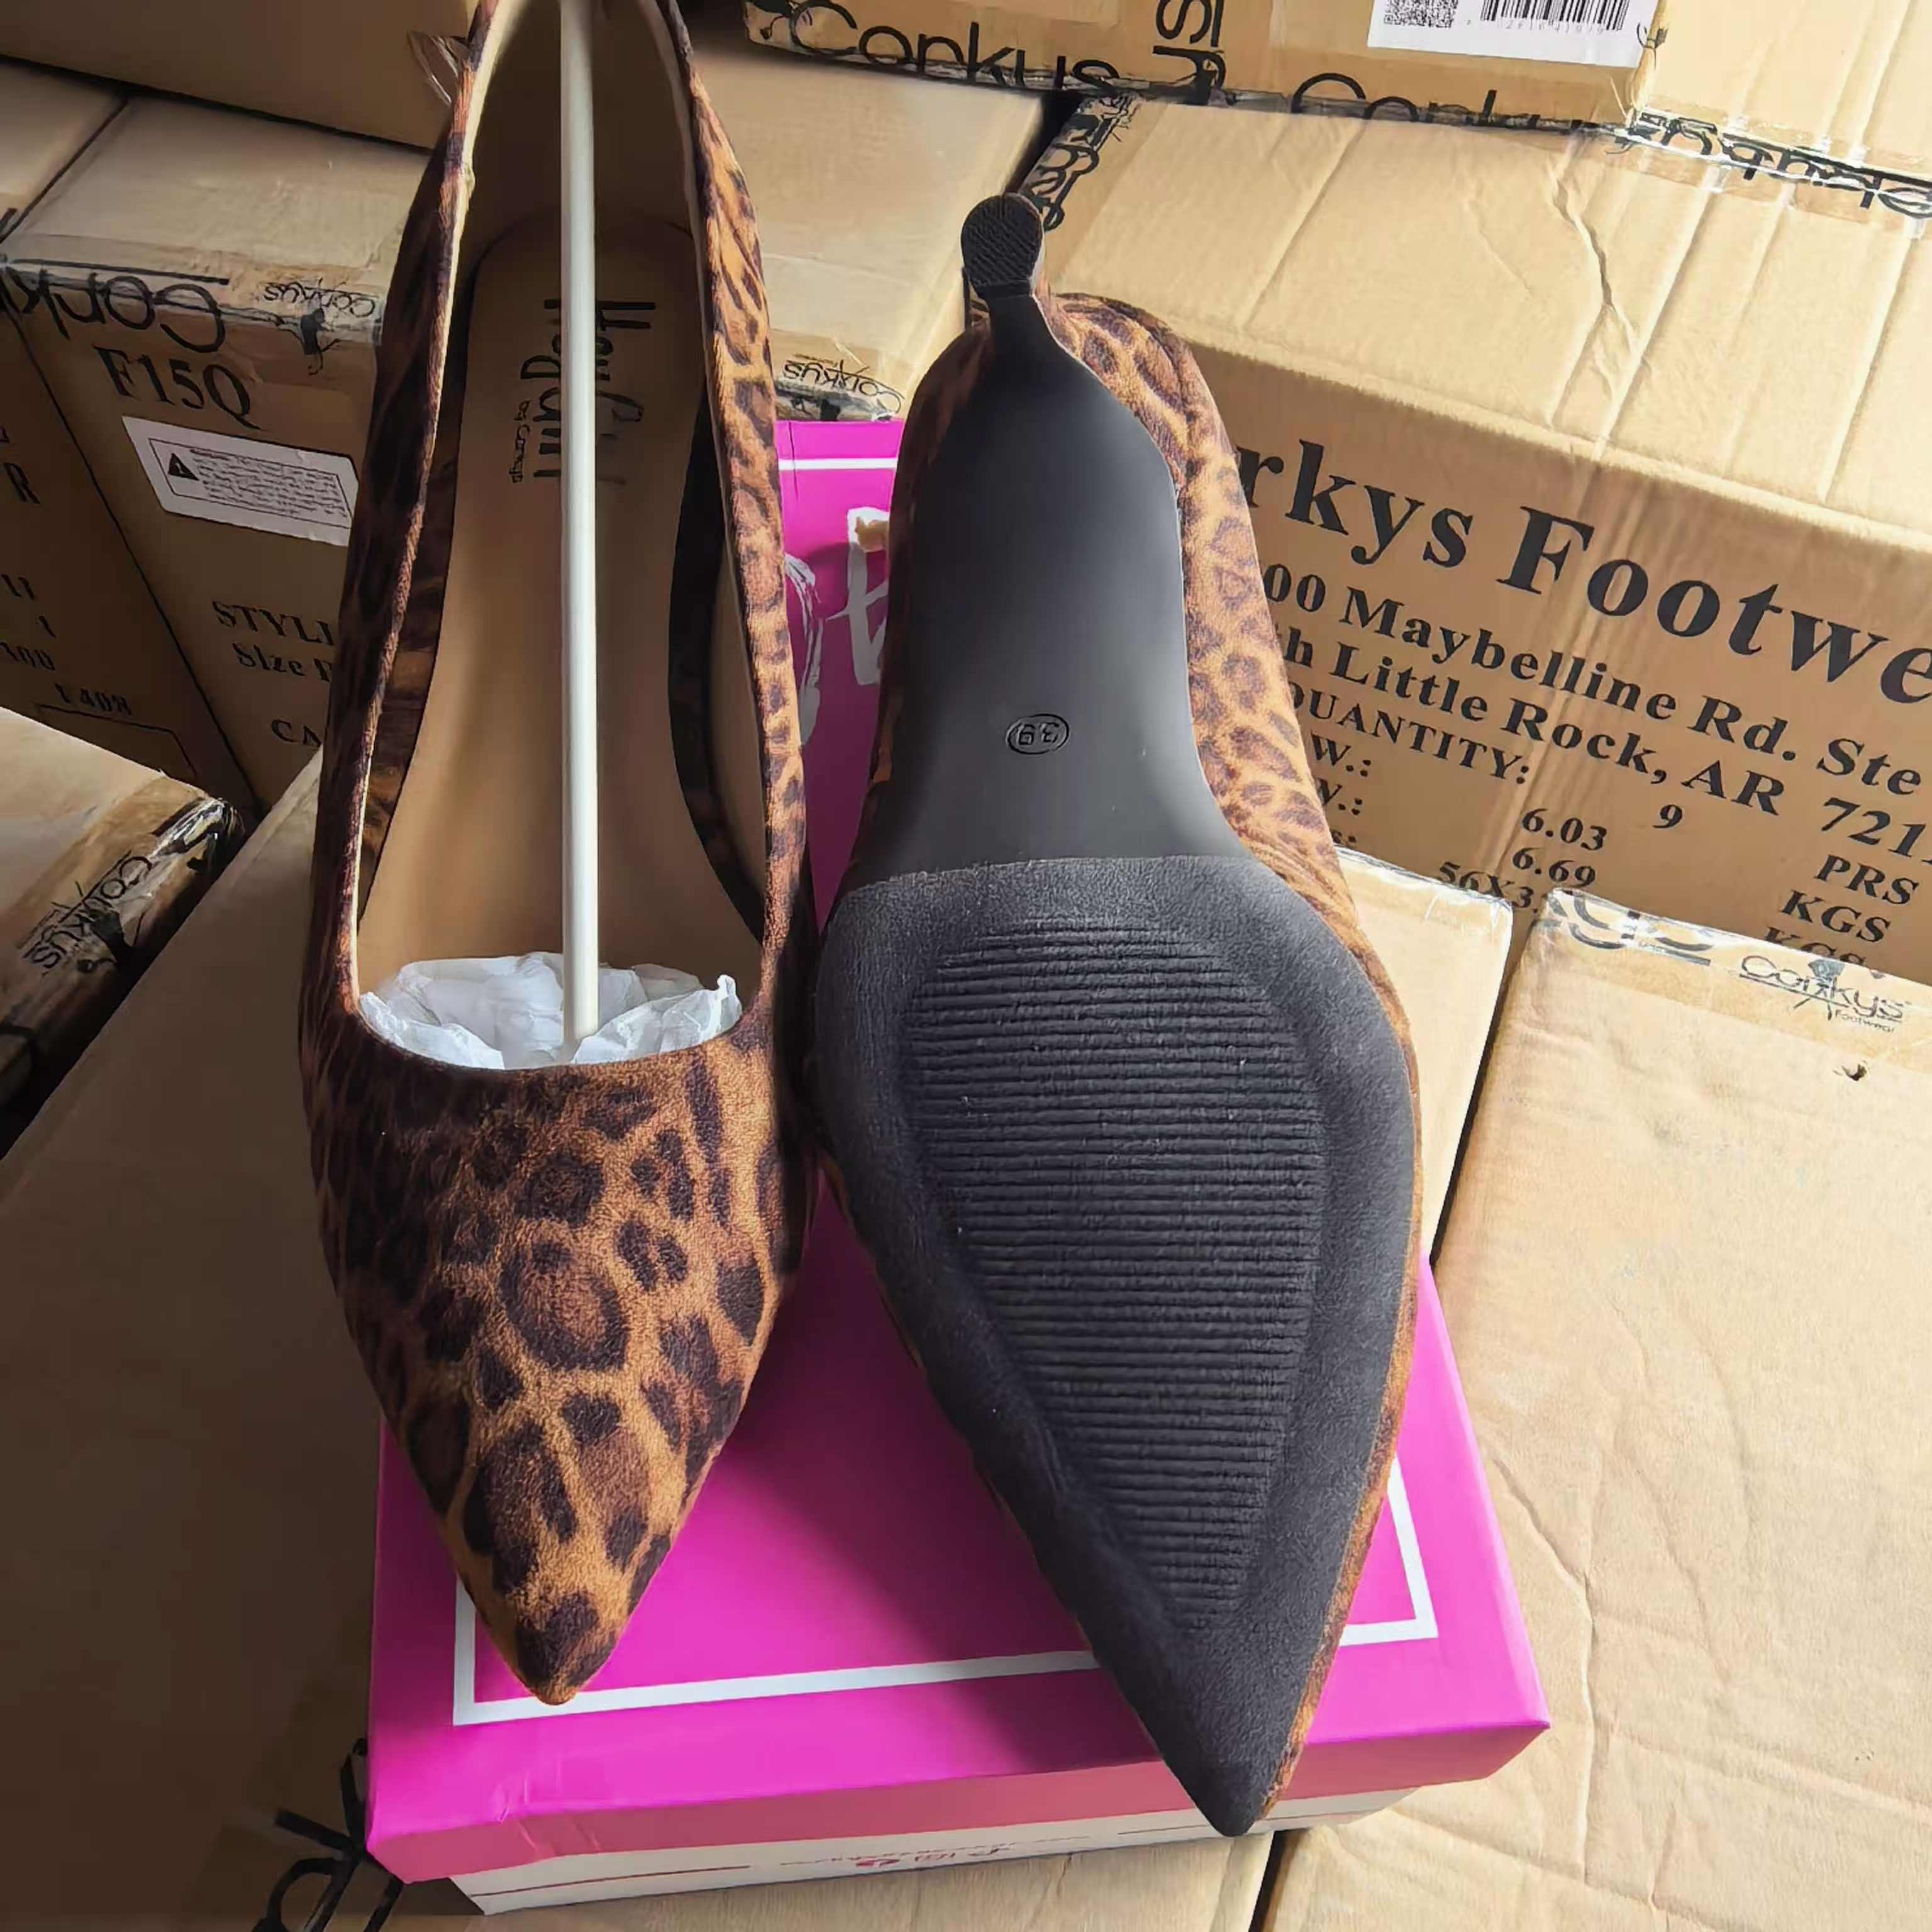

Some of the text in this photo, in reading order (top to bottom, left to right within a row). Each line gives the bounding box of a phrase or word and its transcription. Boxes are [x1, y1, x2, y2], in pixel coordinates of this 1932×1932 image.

[1329, 640, 1489, 722] Little
[1500, 697, 1667, 784] Rock,
[1680, 759, 1785, 816] AR
[1821, 797, 1932, 865] 721
[1338, 586, 1677, 721] Maybelline
[1687, 694, 1796, 761] Rd.
[1816, 738, 1921, 795] Ste
[1512, 847, 1596, 888] 6.69
[1521, 807, 1608, 852] 6.03
[1779, 889, 1892, 943] KGS
[1652, 803, 1684, 830] 9
[1814, 853, 1919, 905] PRS
